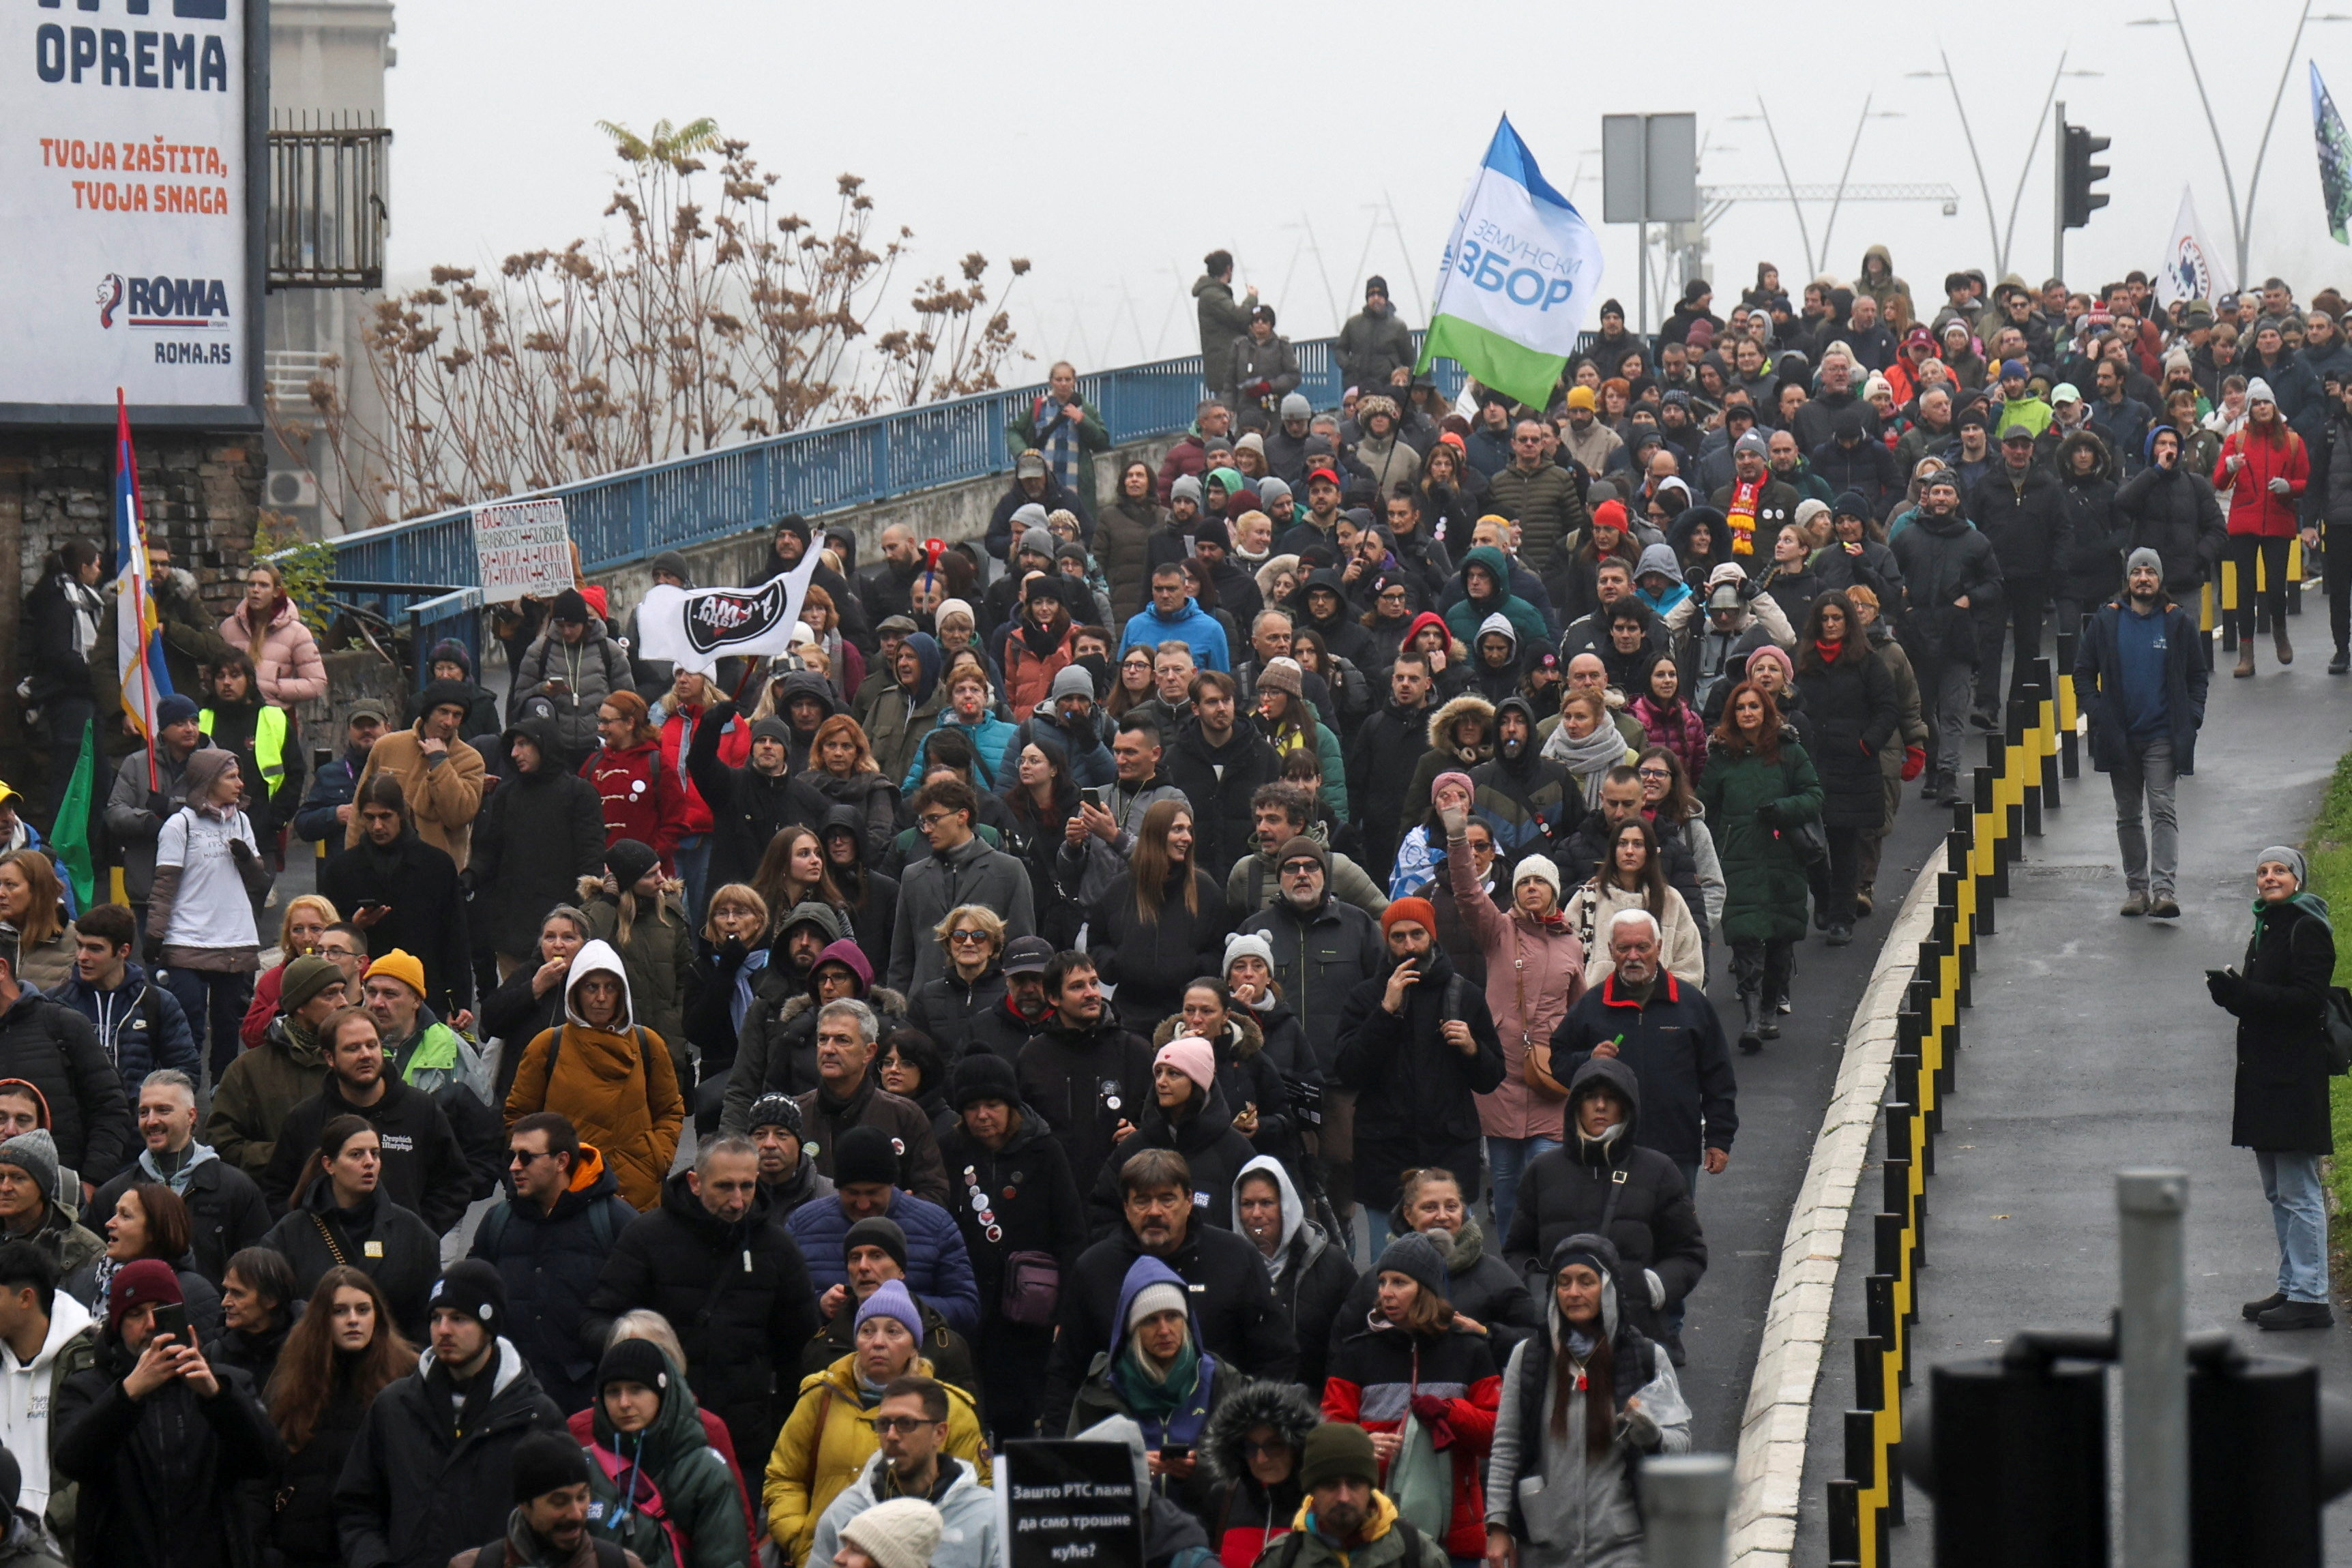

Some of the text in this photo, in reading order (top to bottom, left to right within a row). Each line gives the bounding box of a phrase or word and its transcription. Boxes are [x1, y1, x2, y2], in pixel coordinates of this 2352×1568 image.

[36, 23, 227, 92] OPREMA
[40, 134, 228, 179] TVOJA ZAŠTITA,
[72, 180, 228, 214] TVOJA SNAGA
[1473, 218, 1583, 275] ЗЕМУНСКИ
[1458, 239, 1573, 312] ЗБОР
[128, 276, 229, 318] ROMA
[154, 342, 231, 365] ROMA.RS
[475, 512, 497, 530] FDU
[531, 524, 565, 545] SLOBODE
[1014, 1484, 1132, 1499] Зашто РТС лаже
[1018, 1515, 1130, 1532] да смо трошне
[1052, 1543, 1096, 1562] куће?
